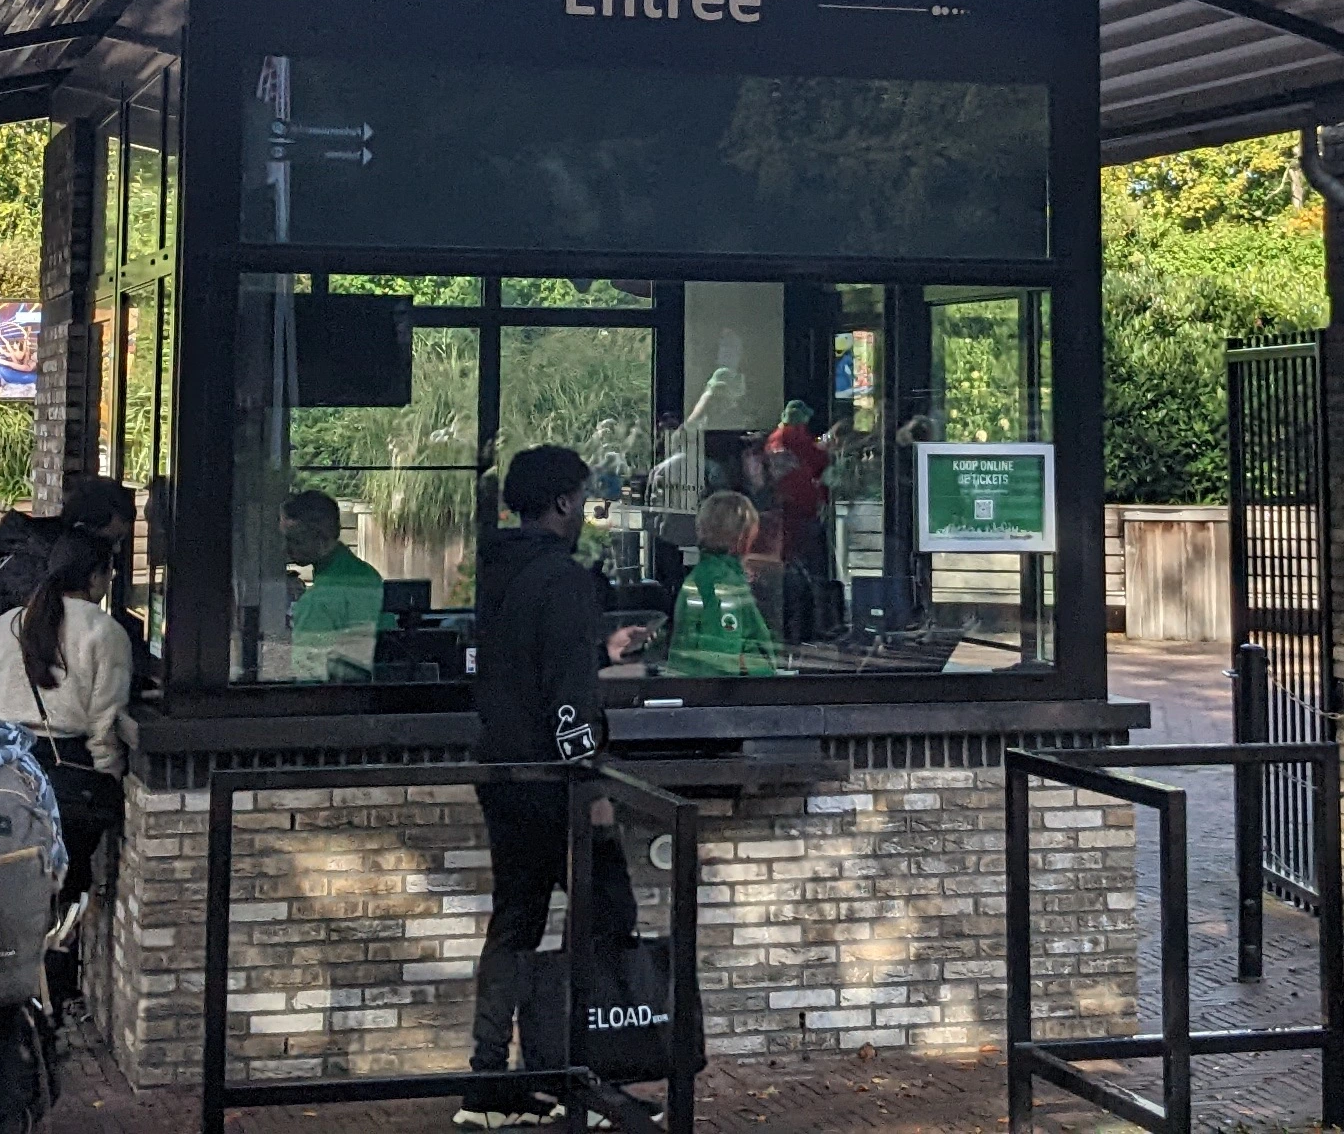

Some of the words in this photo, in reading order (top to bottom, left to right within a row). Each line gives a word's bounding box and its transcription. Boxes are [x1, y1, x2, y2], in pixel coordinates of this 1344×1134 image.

[952, 460, 978, 471] KOOP
[980, 460, 1014, 471] ONLINE
[972, 473, 1009, 485] TICKETS
[588, 1005, 652, 1029] ELOAD
